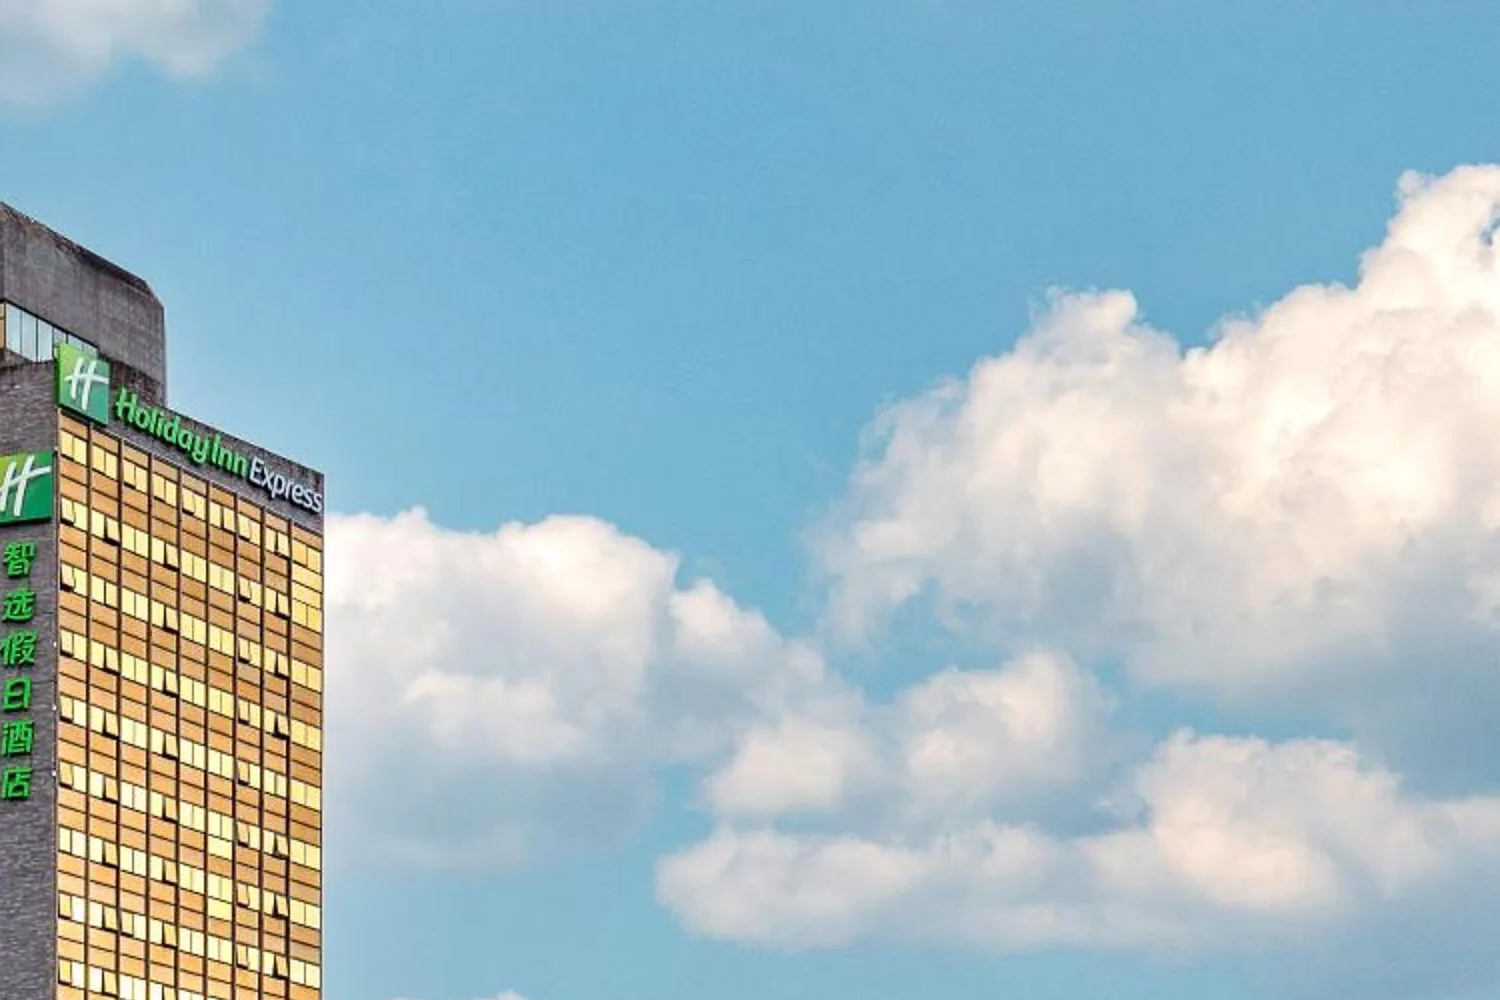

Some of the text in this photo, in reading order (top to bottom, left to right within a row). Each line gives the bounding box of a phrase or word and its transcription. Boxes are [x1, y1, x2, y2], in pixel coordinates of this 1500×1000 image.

[115, 386, 323, 513] Holiday Inn Express
[0, 541, 37, 800] 智选假日酒店
